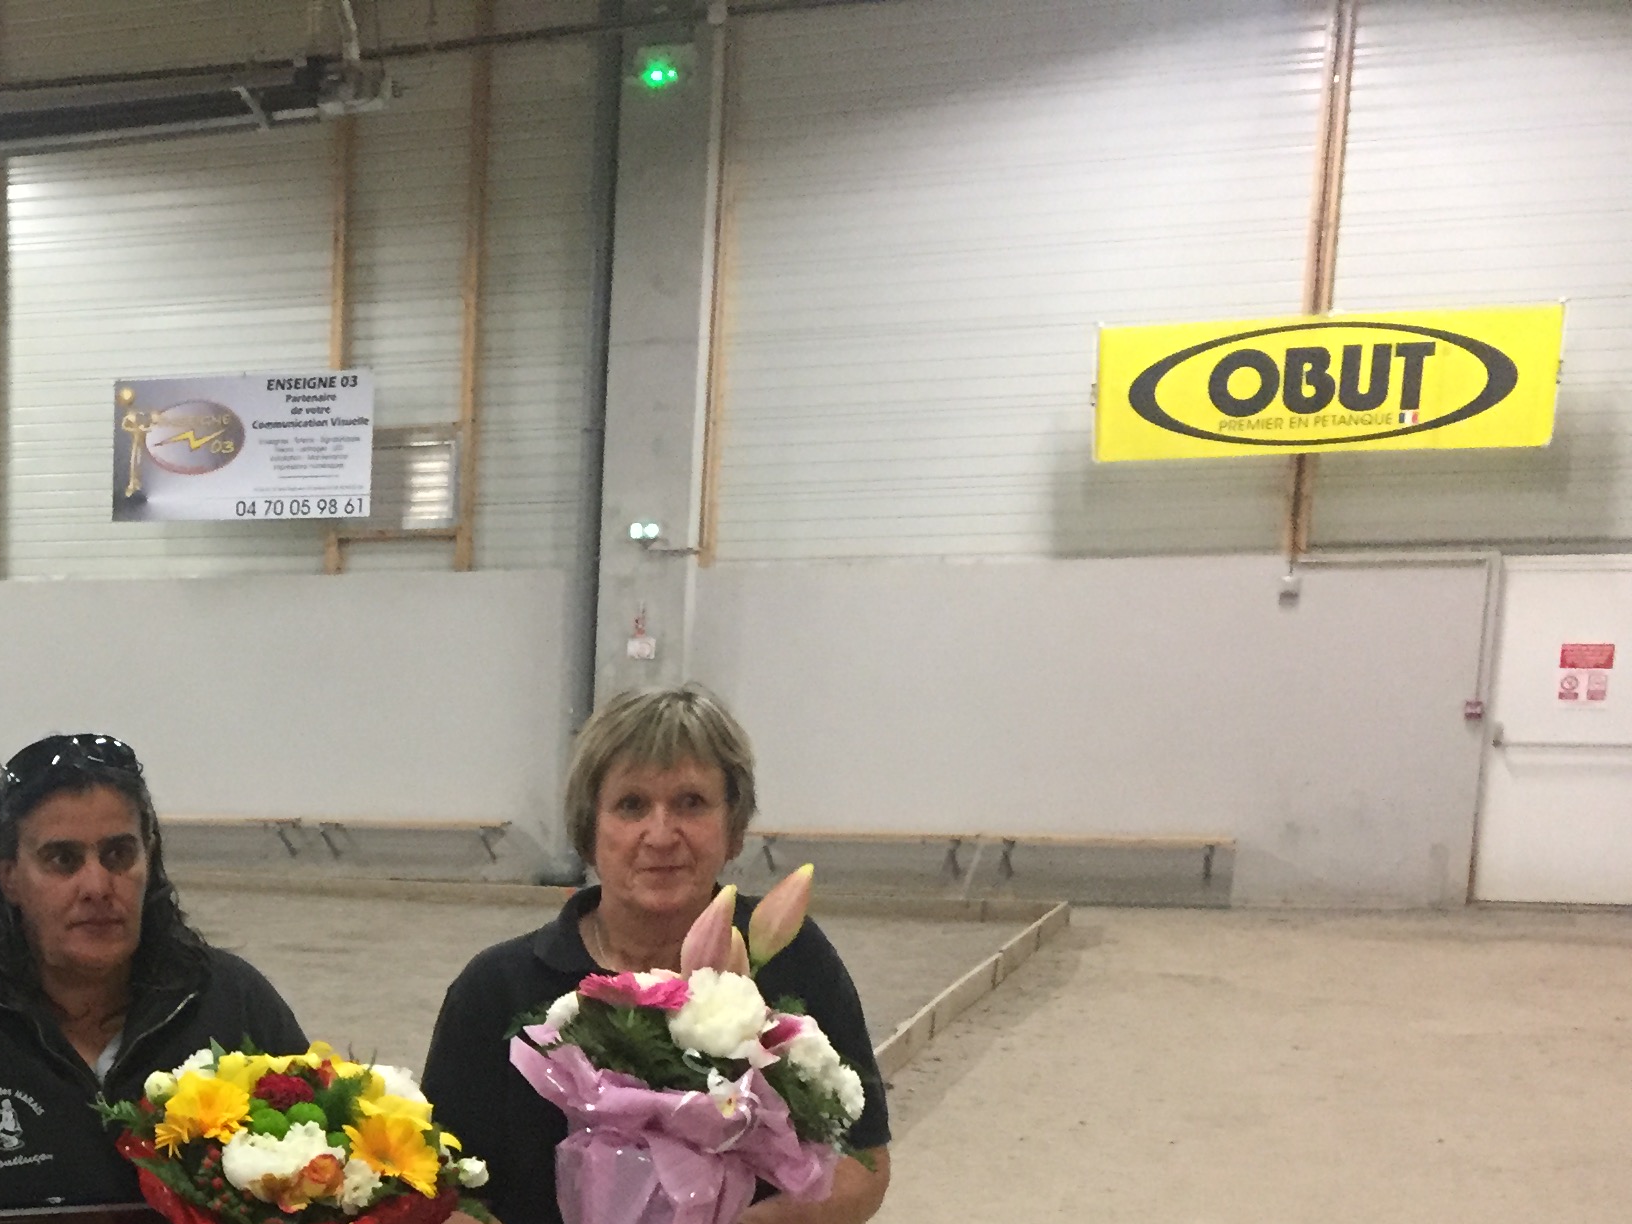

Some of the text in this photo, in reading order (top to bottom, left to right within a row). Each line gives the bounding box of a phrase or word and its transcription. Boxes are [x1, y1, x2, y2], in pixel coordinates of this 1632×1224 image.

[266, 375, 358, 391] ENSEIGNE 03
[1209, 342, 1436, 418] OBUT
[285, 393, 337, 403] Partenaire
[290, 406, 331, 415] de votre
[251, 416, 370, 430] Communication Visuelle
[1218, 411, 1394, 432] PREMIER EN PETANQUE
[210, 439, 236, 454] 03
[235, 497, 363, 517] 04 70 05 98 61
